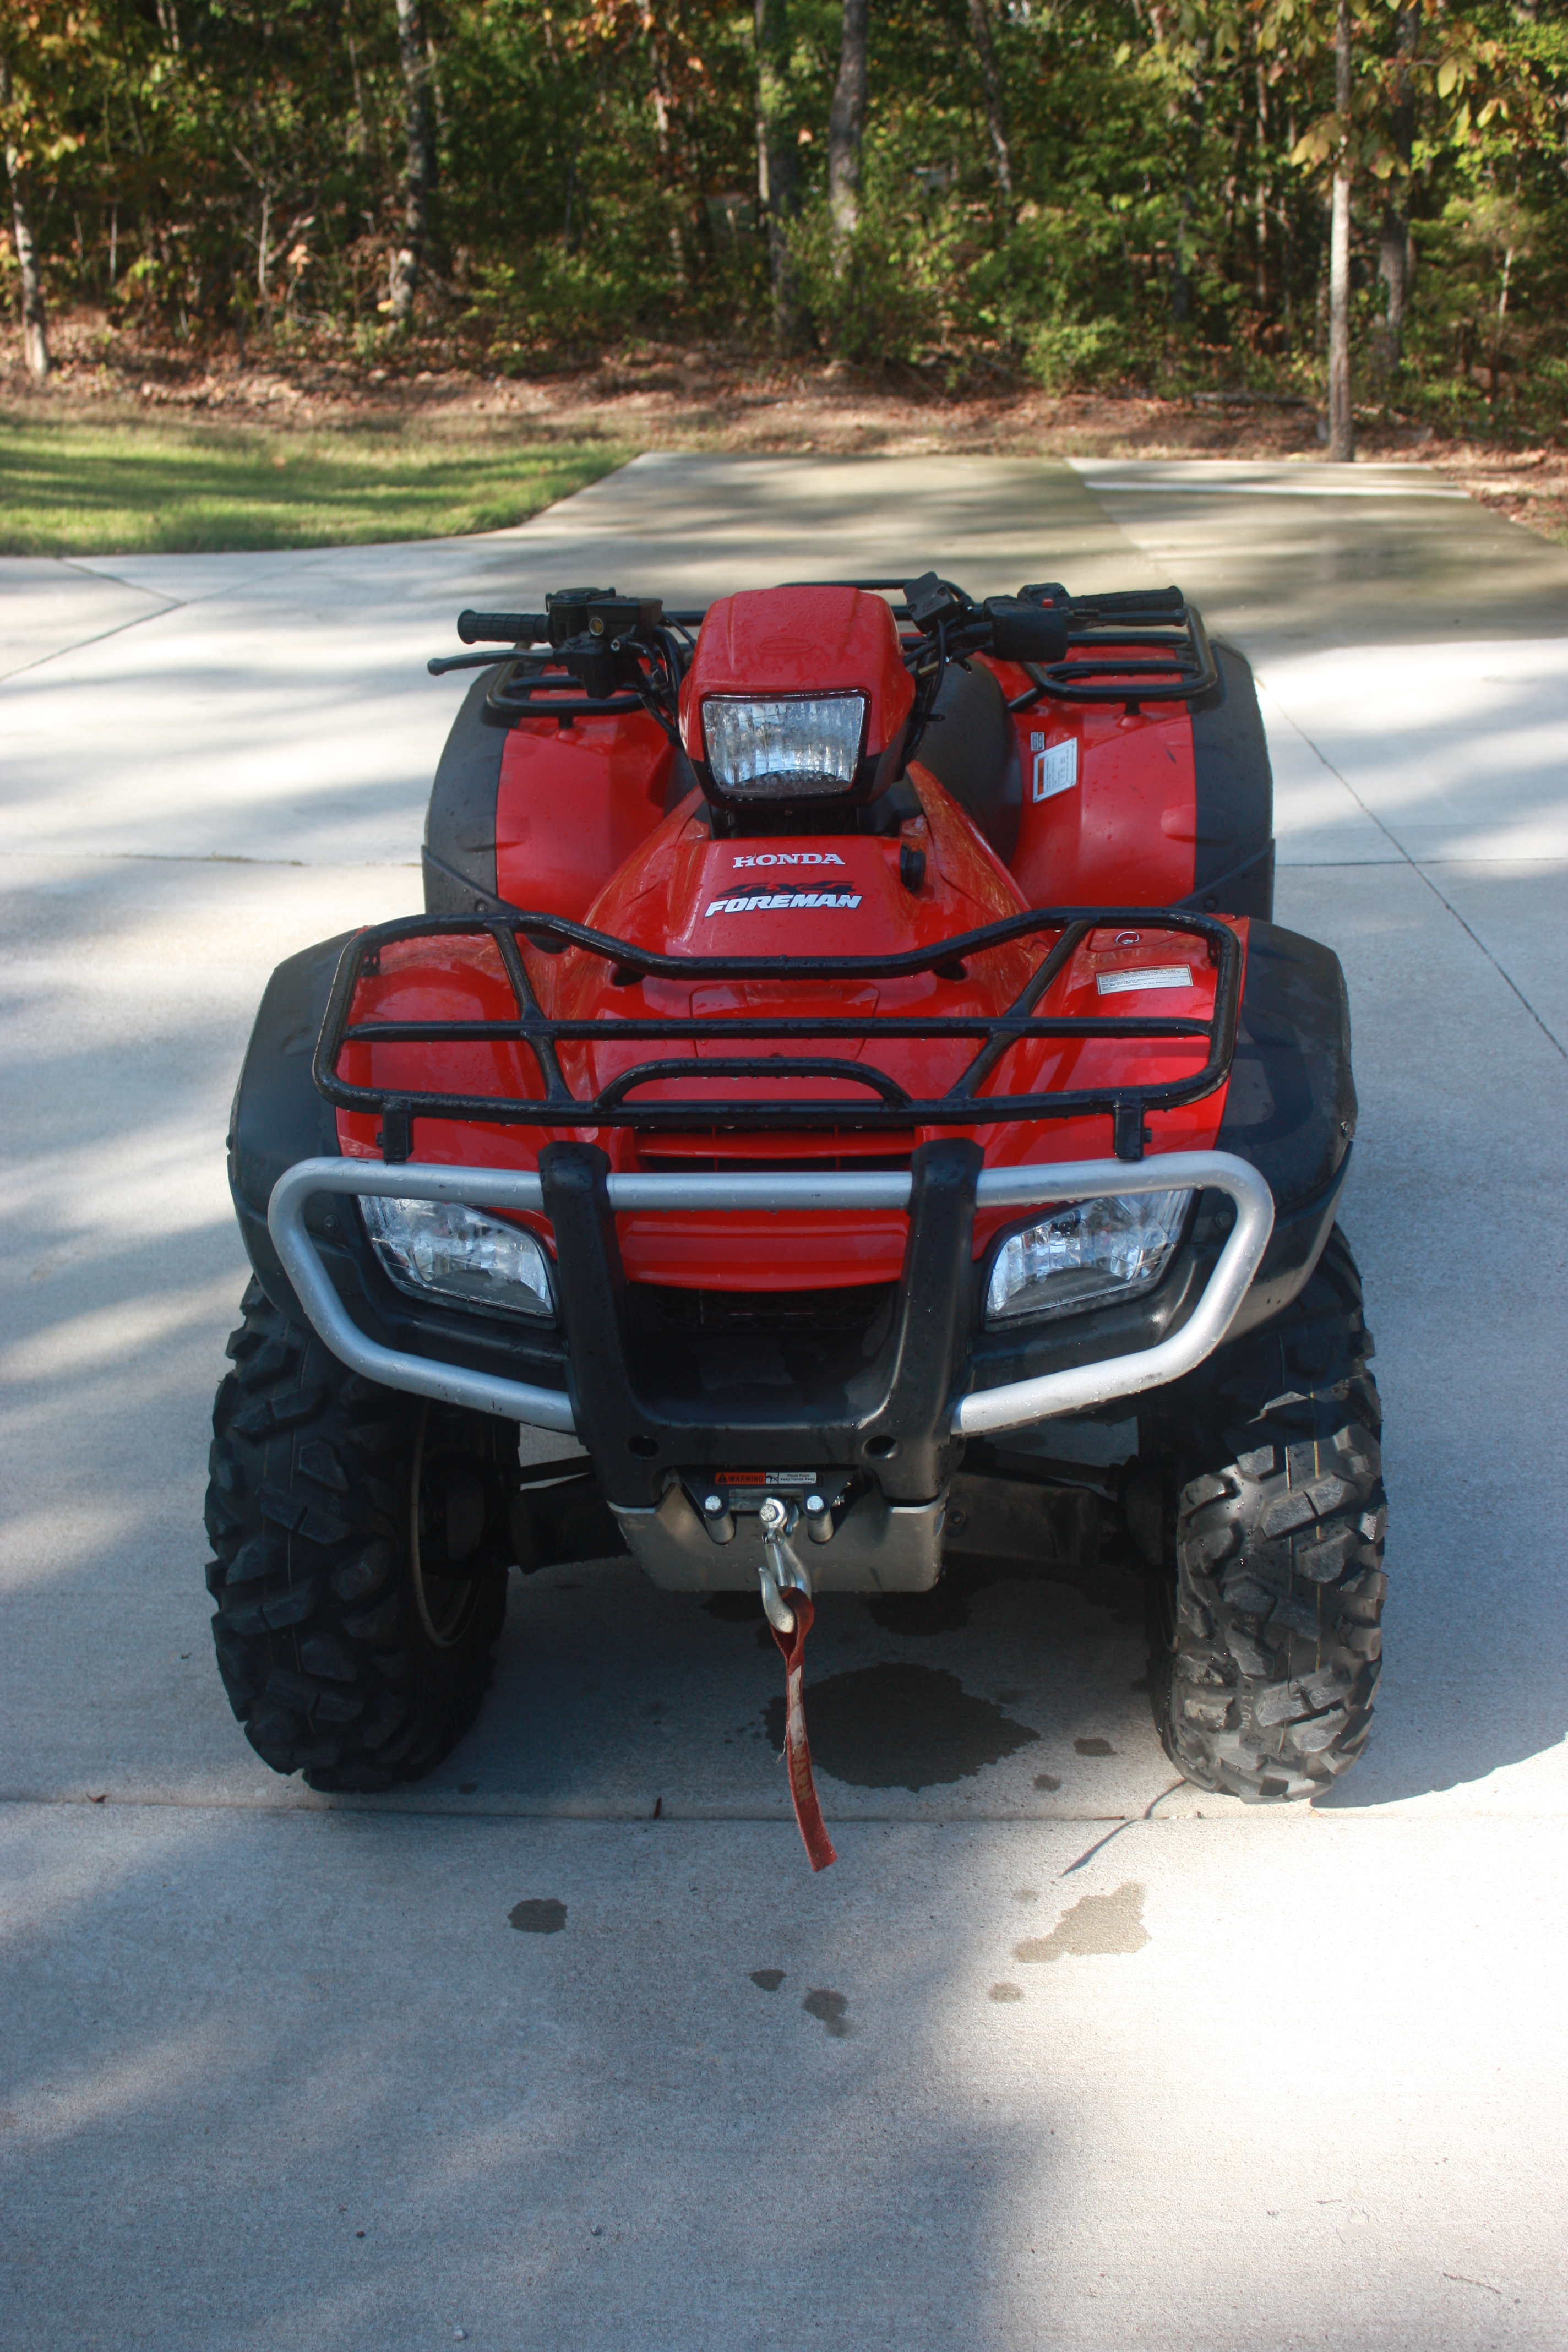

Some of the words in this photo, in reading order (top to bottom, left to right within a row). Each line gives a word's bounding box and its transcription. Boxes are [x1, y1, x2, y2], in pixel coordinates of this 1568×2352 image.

[733, 853, 846, 868] HONDA
[704, 894, 863, 917] FOREMAN
[728, 1474, 764, 1483] WARNING
